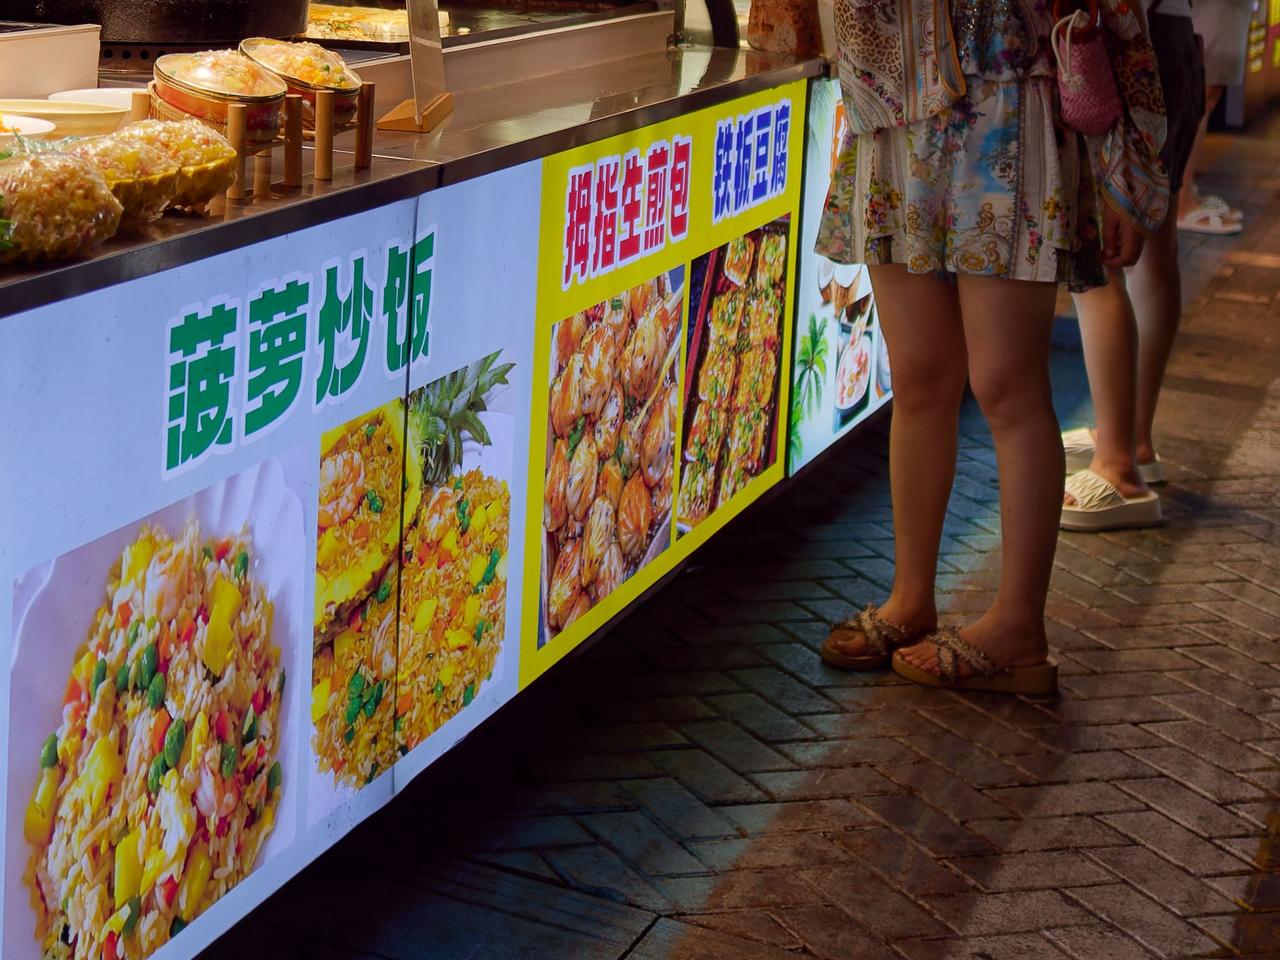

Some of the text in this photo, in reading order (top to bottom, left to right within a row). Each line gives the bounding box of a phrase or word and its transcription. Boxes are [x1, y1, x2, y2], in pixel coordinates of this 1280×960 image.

[565, 140, 691, 286] 拇指生煎包
[714, 105, 790, 219] 铁板豆腐
[166, 232, 435, 471] 菠萝炒饭
